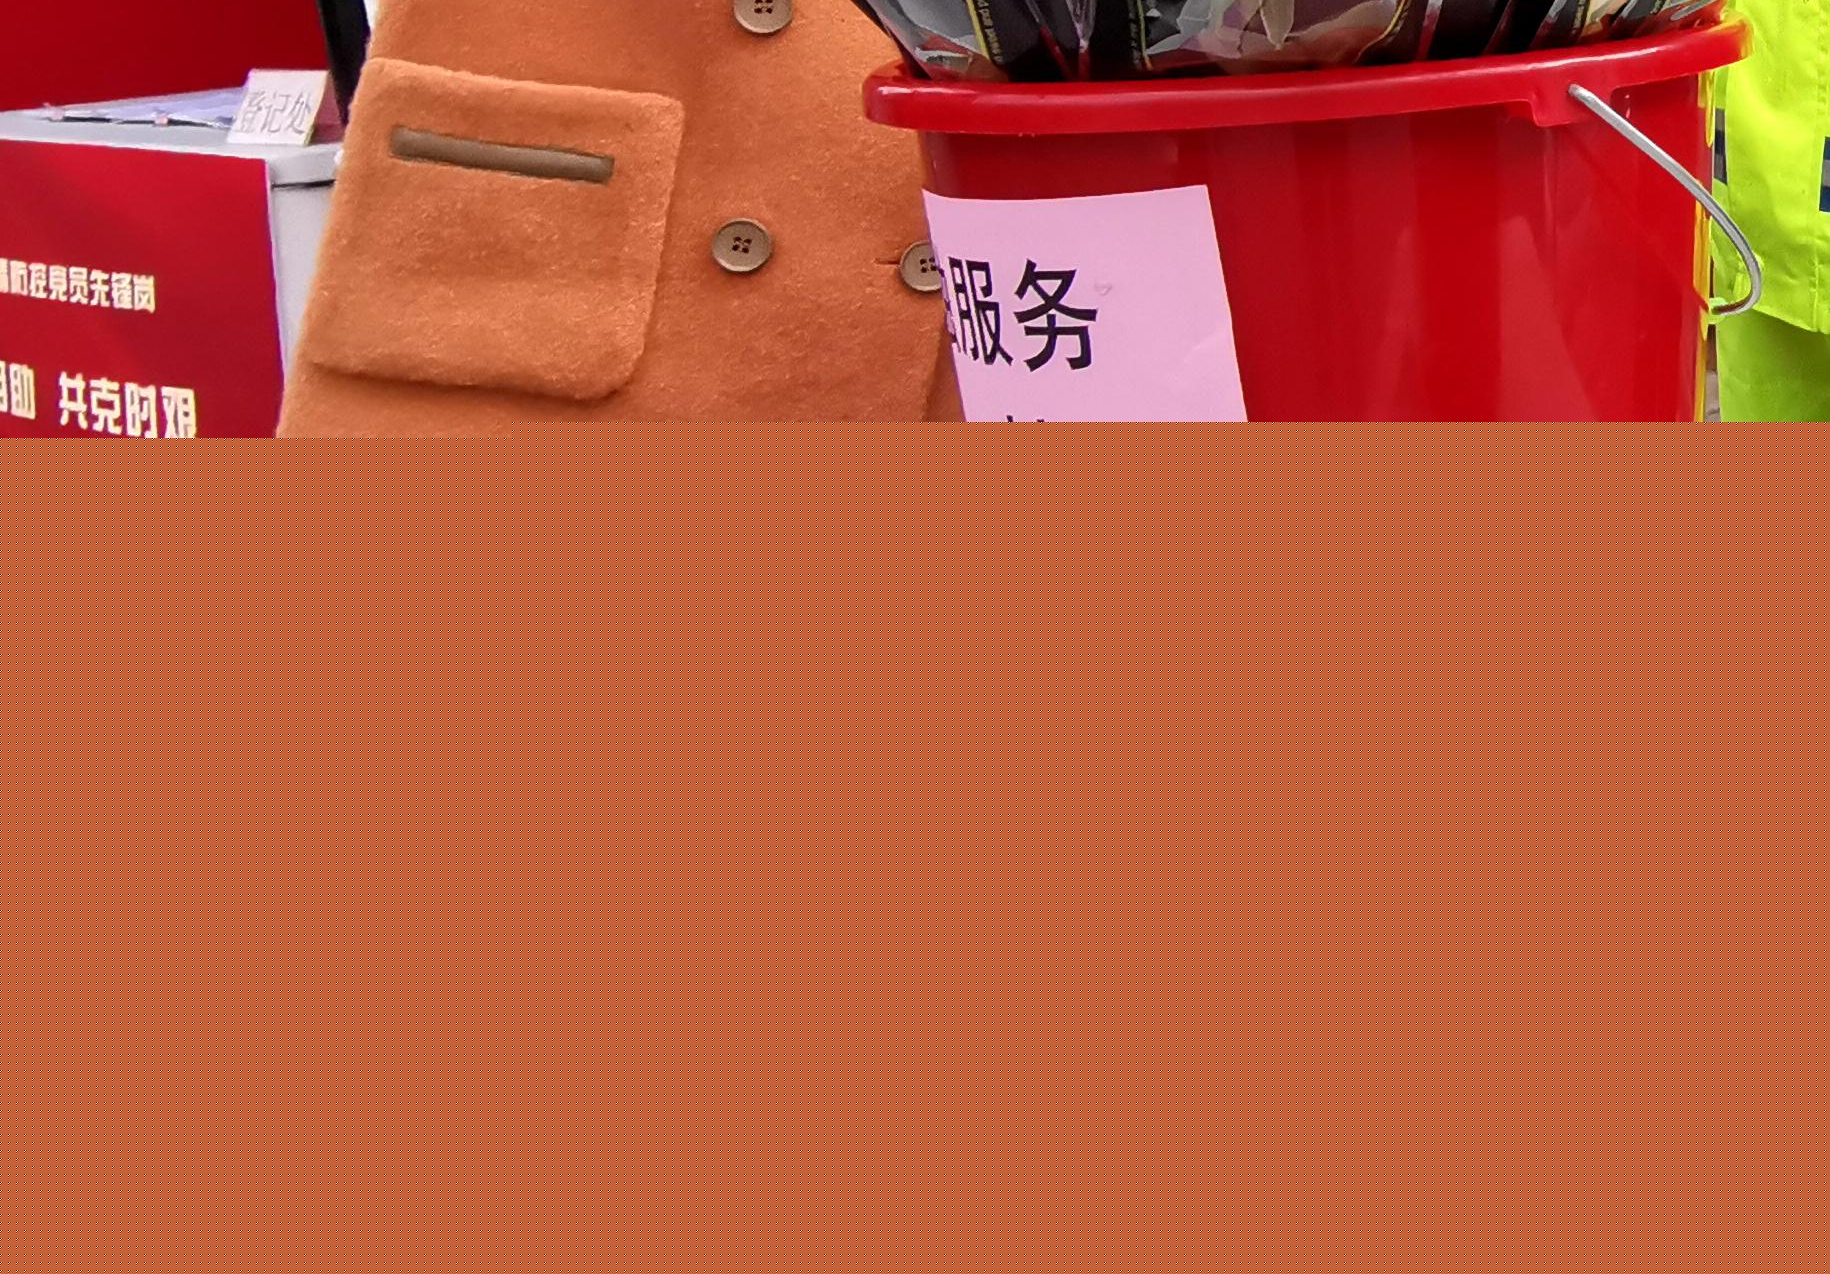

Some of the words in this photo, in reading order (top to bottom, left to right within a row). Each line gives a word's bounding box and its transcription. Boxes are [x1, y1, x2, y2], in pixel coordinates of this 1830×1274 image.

[940, 256, 1099, 372] 服务
[58, 371, 197, 437] 共克时艰
